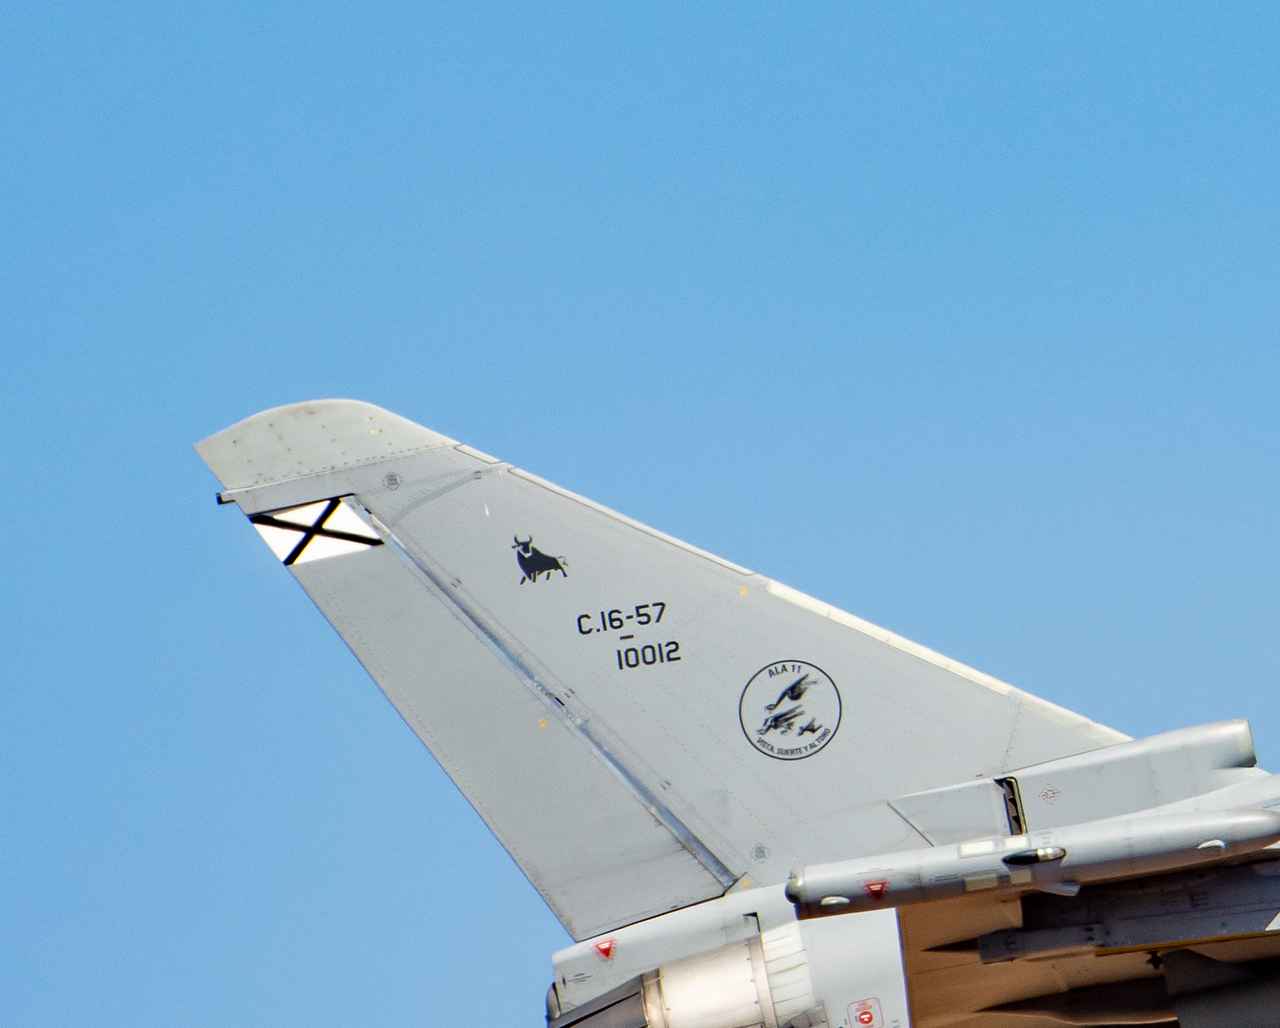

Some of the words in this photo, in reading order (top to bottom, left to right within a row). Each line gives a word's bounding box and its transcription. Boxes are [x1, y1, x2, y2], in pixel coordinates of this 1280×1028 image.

[577, 601, 667, 635] C.16-57
[616, 640, 682, 670] 10012
[768, 664, 788, 679] ALA
[791, 664, 802, 673] 11
[777, 747, 803, 756] SUERTE
[809, 741, 818, 750] AL
[815, 728, 831, 744] TORO
